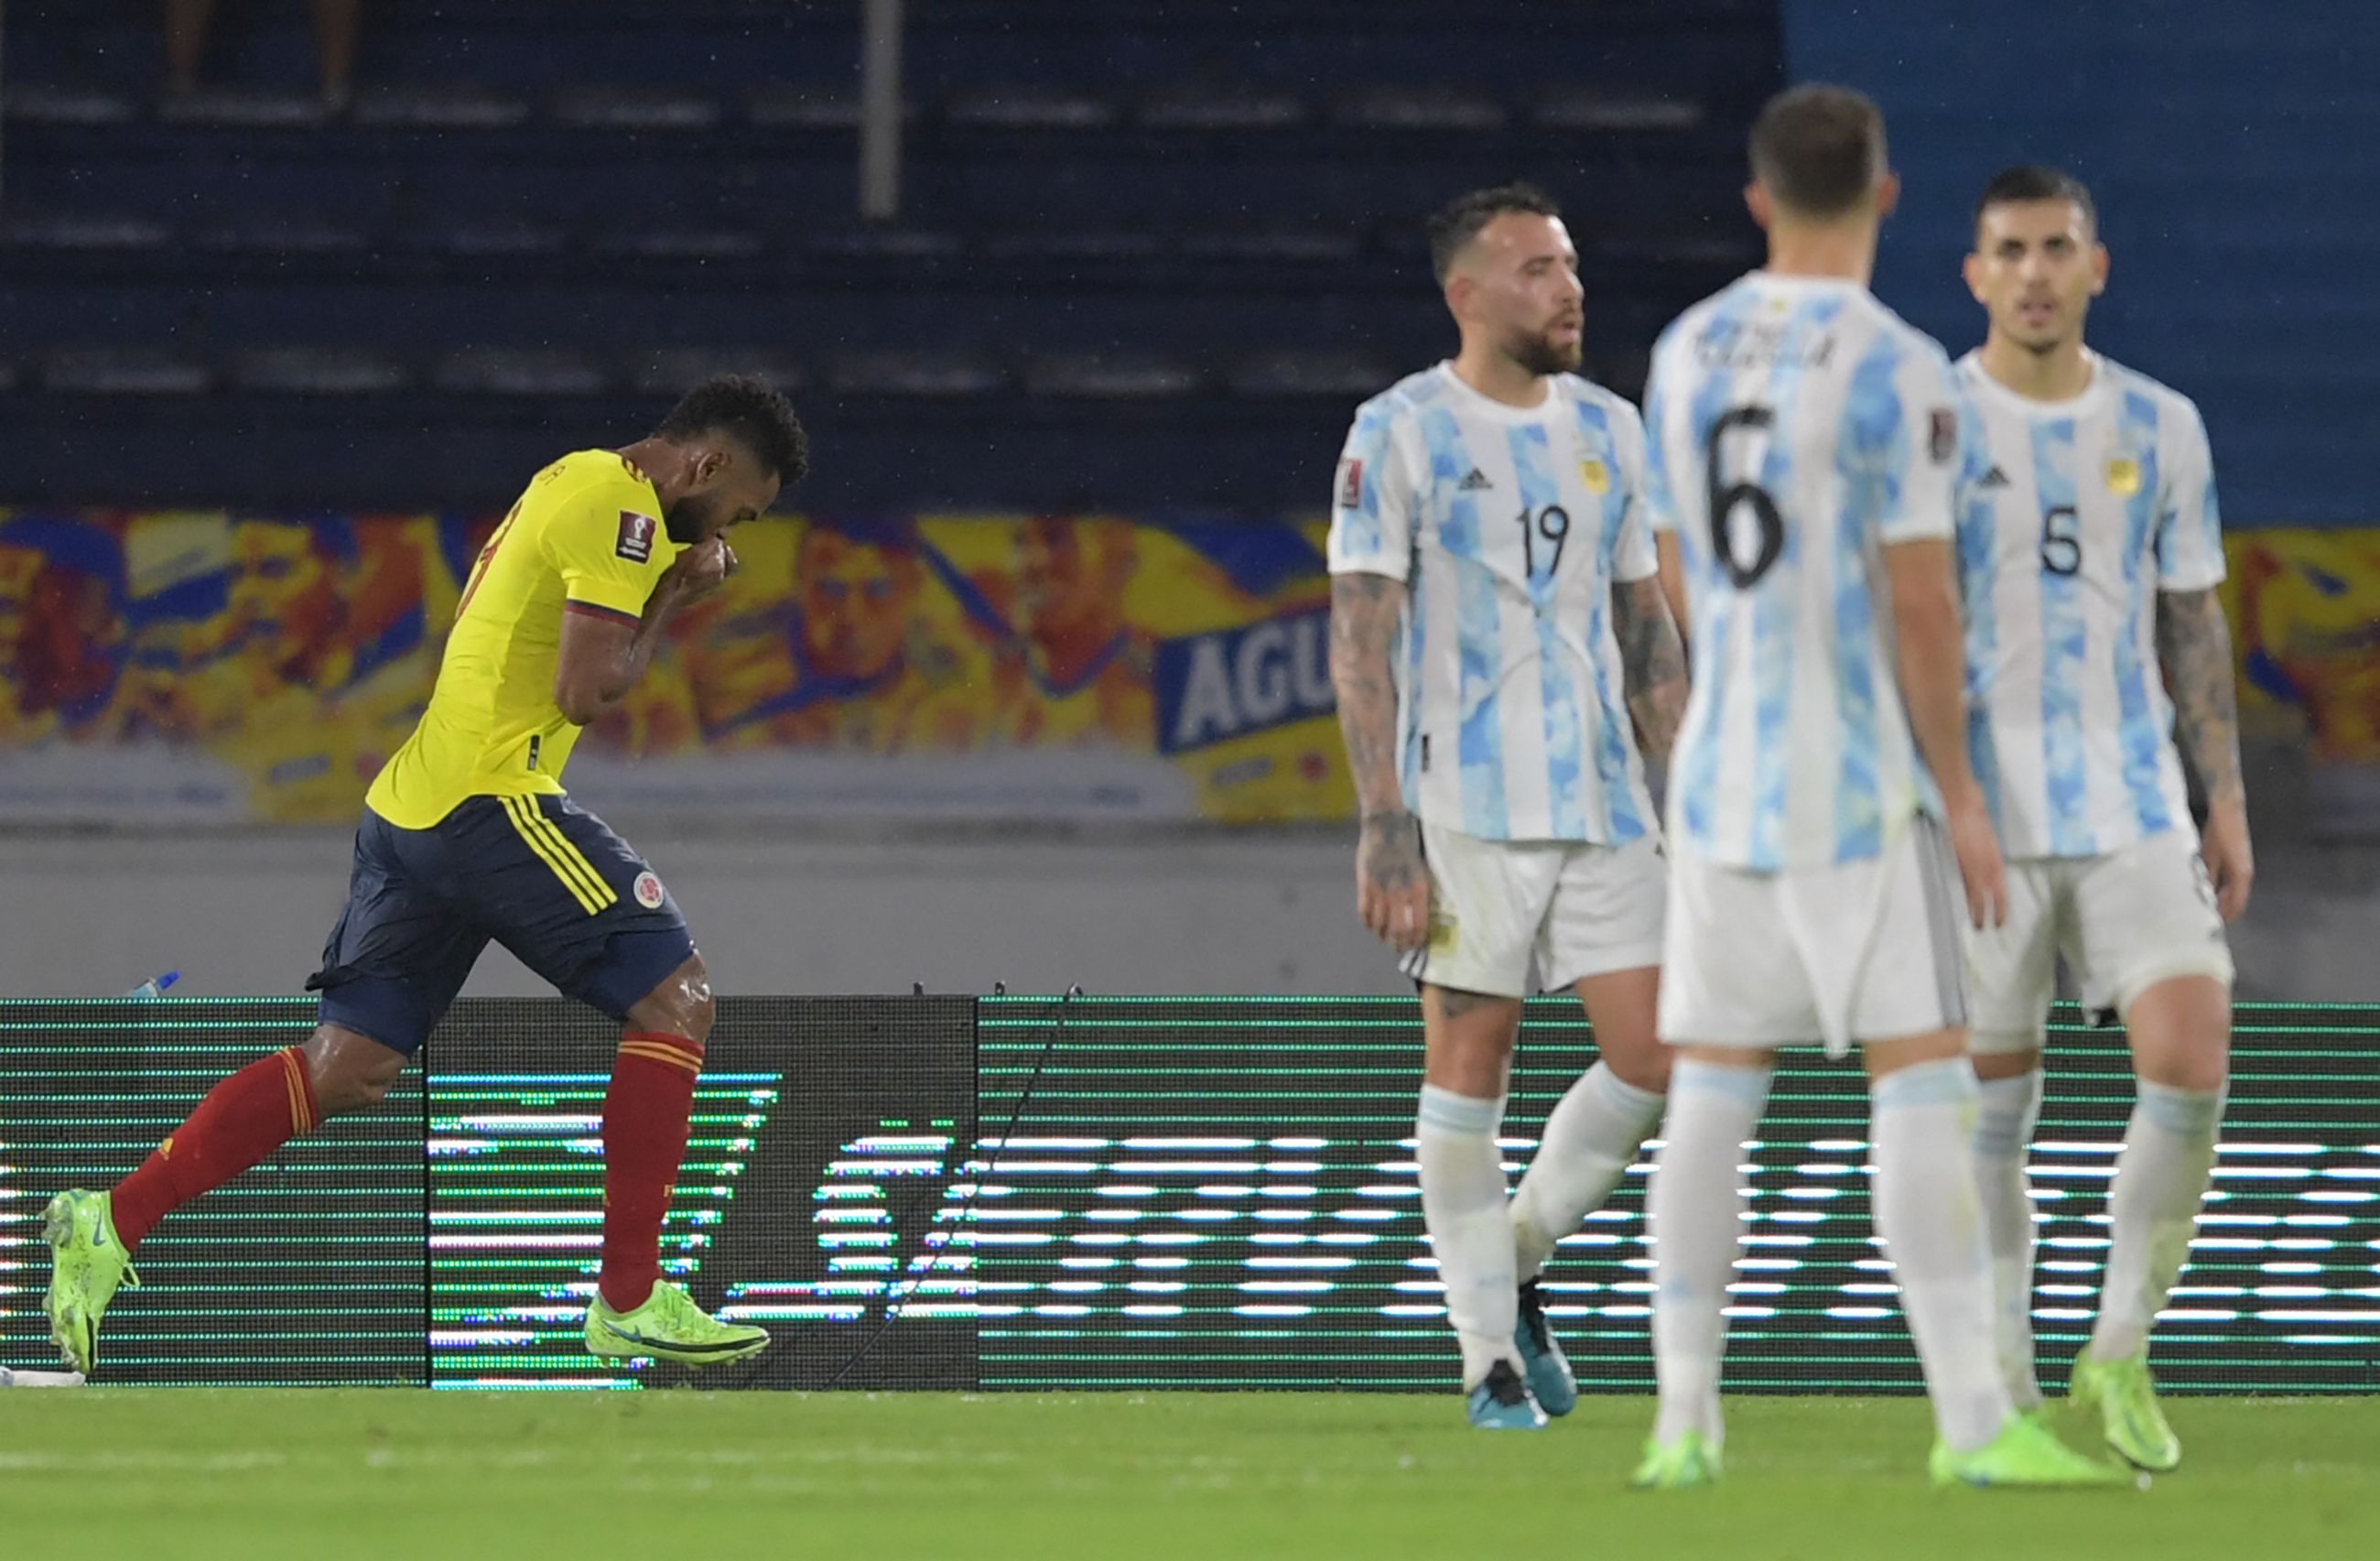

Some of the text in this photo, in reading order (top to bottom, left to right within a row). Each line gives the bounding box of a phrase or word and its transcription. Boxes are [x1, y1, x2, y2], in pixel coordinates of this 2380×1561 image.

[1707, 406, 1782, 589] 6
[1515, 505, 1569, 579] 19
[2041, 506, 2082, 576] 5
